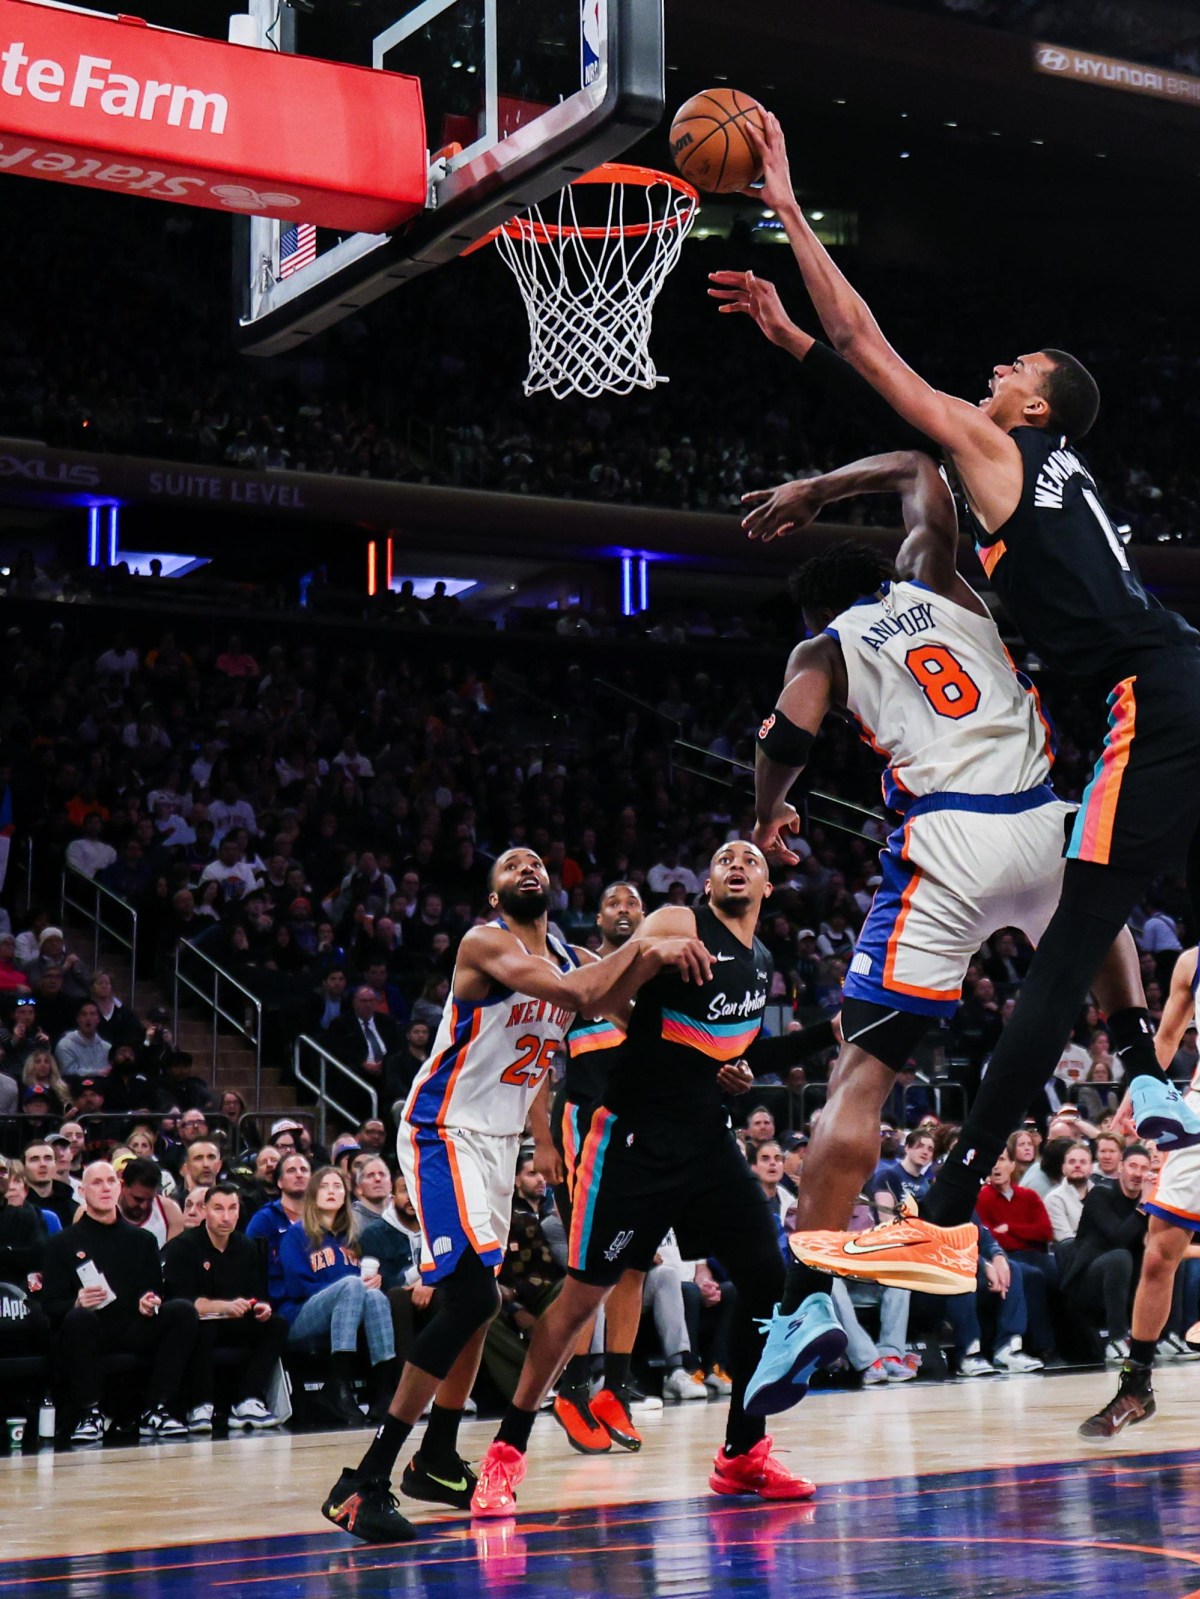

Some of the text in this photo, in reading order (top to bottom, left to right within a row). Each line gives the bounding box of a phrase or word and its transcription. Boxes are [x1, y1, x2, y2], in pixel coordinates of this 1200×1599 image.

[1073, 57, 1162, 91] HYUNDAI
[150, 472, 221, 496] SUITE
[230, 479, 304, 507] LEVEL
[904, 643, 982, 721] 8
[706, 992, 738, 1021] San
[500, 1033, 560, 1089] 25
